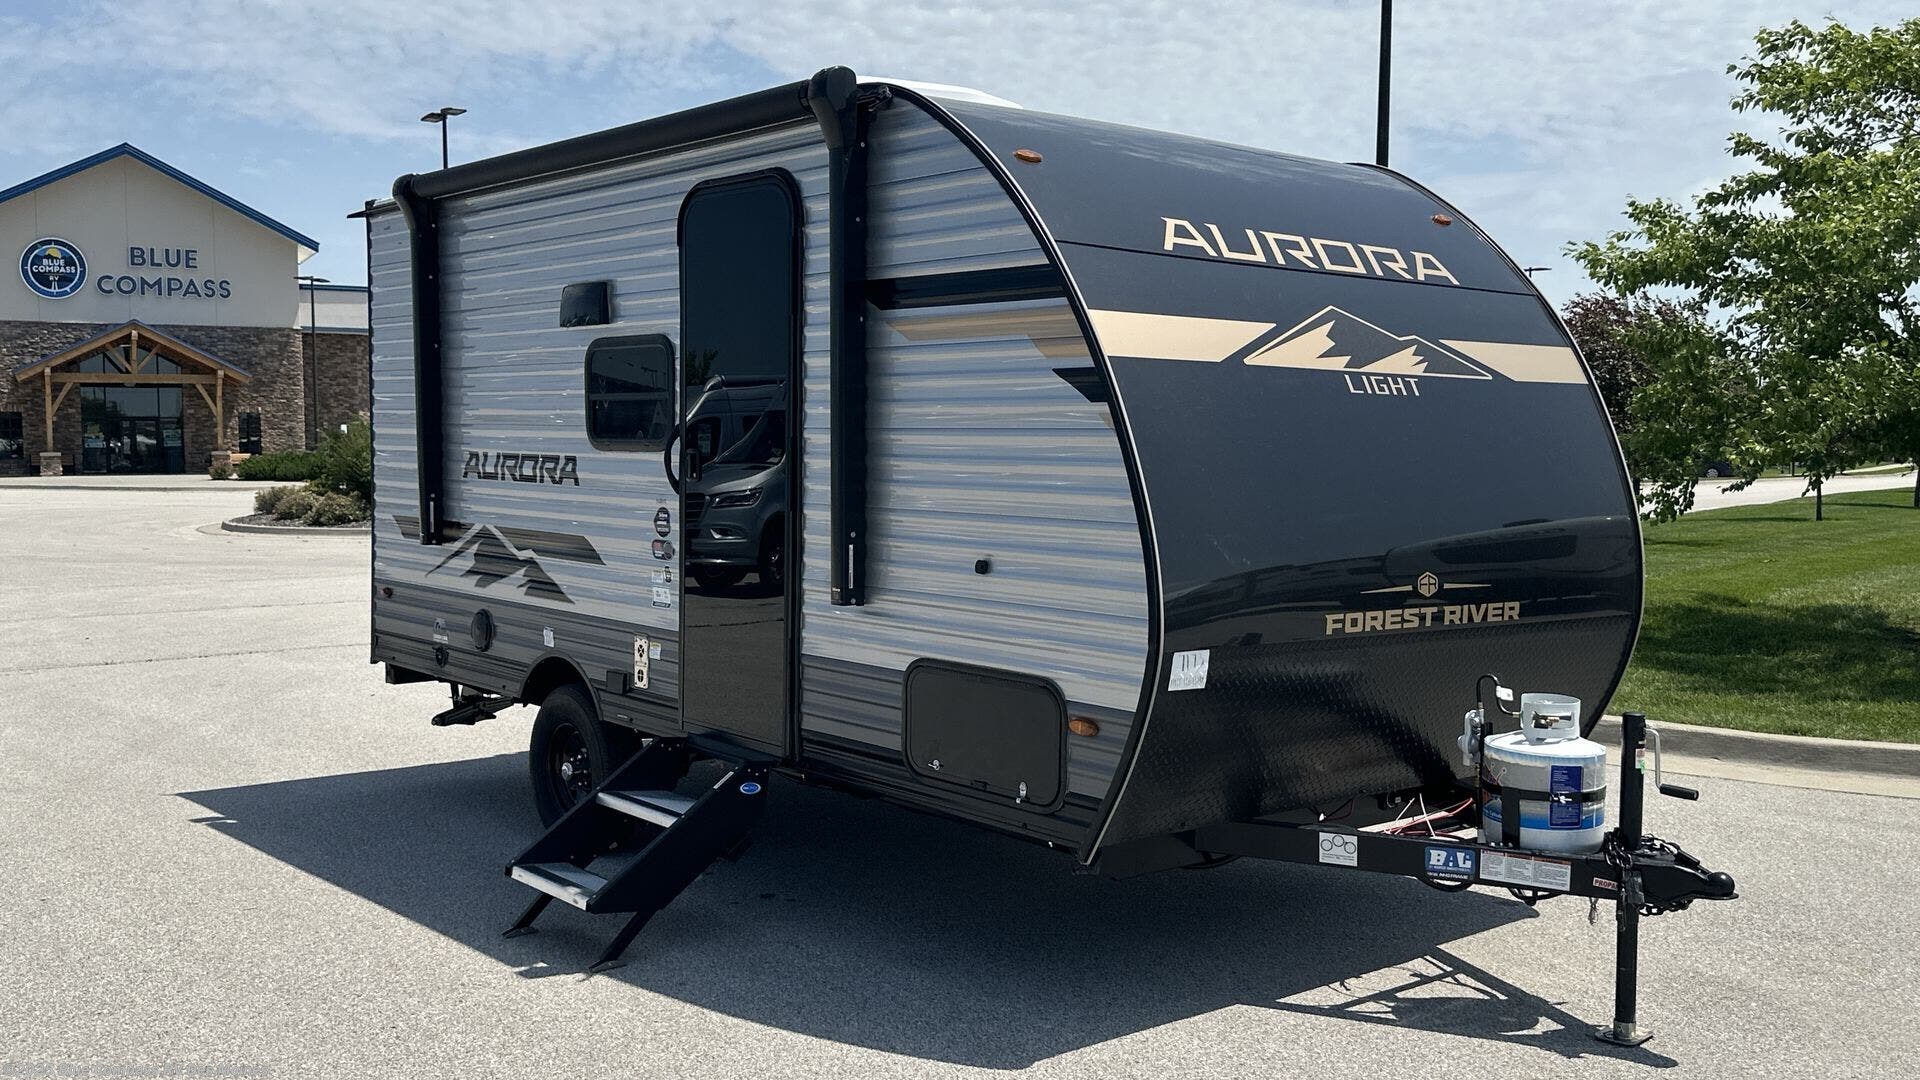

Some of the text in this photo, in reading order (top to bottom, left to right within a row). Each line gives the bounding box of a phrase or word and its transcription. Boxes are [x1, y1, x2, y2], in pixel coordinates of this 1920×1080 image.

[42, 258, 65, 266] BLUE
[129, 246, 198, 269] BLUE
[1161, 216, 1460, 285] AURORA
[32, 265, 76, 273] COMPASS
[97, 274, 232, 299] COMPASS
[1344, 374, 1420, 397] LIGHT
[462, 451, 580, 487] AURORA
[1325, 601, 1521, 635] FOREST RIVER
[1594, 879, 1617, 889] PROPA
